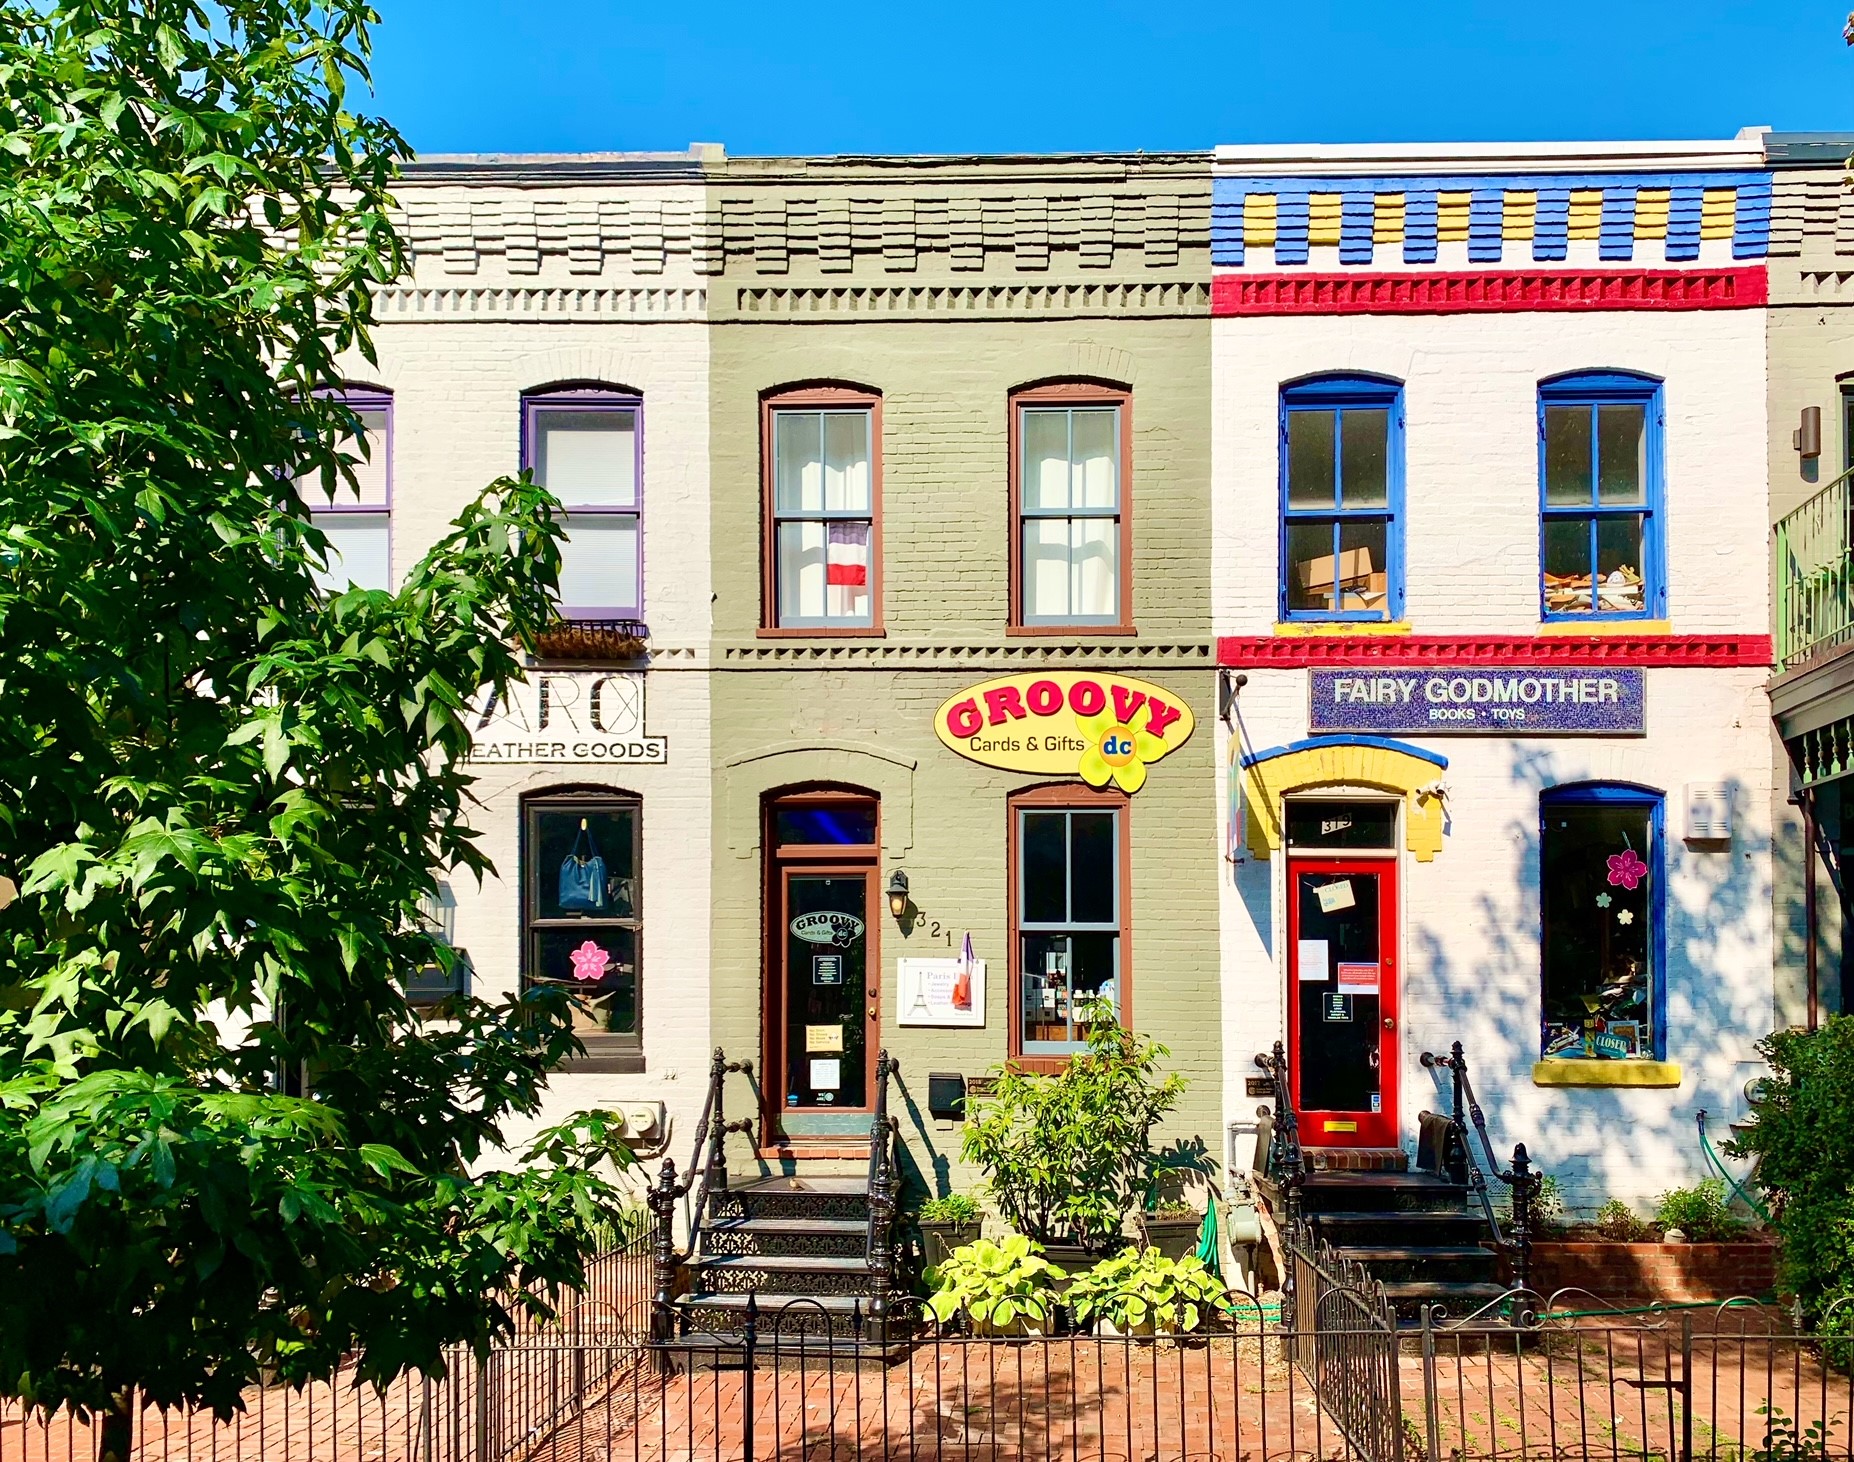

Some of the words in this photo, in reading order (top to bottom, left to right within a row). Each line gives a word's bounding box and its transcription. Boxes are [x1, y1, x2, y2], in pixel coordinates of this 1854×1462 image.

[1334, 678, 1415, 704] FAIRY
[1425, 678, 1619, 704] GODMOTHER
[946, 680, 1182, 739] GROOVY
[1429, 708, 1475, 721] BOOKS
[1492, 708, 1525, 721] TOYS
[573, 742, 660, 759] GOODS
[970, 736, 1020, 752] Cards
[1026, 736, 1039, 752] &
[1045, 735, 1085, 752] Gifts
[1103, 736, 1132, 755] dc
[1324, 814, 1350, 832] 319
[796, 914, 859, 931] GROOVY
[916, 911, 952, 947] 321
